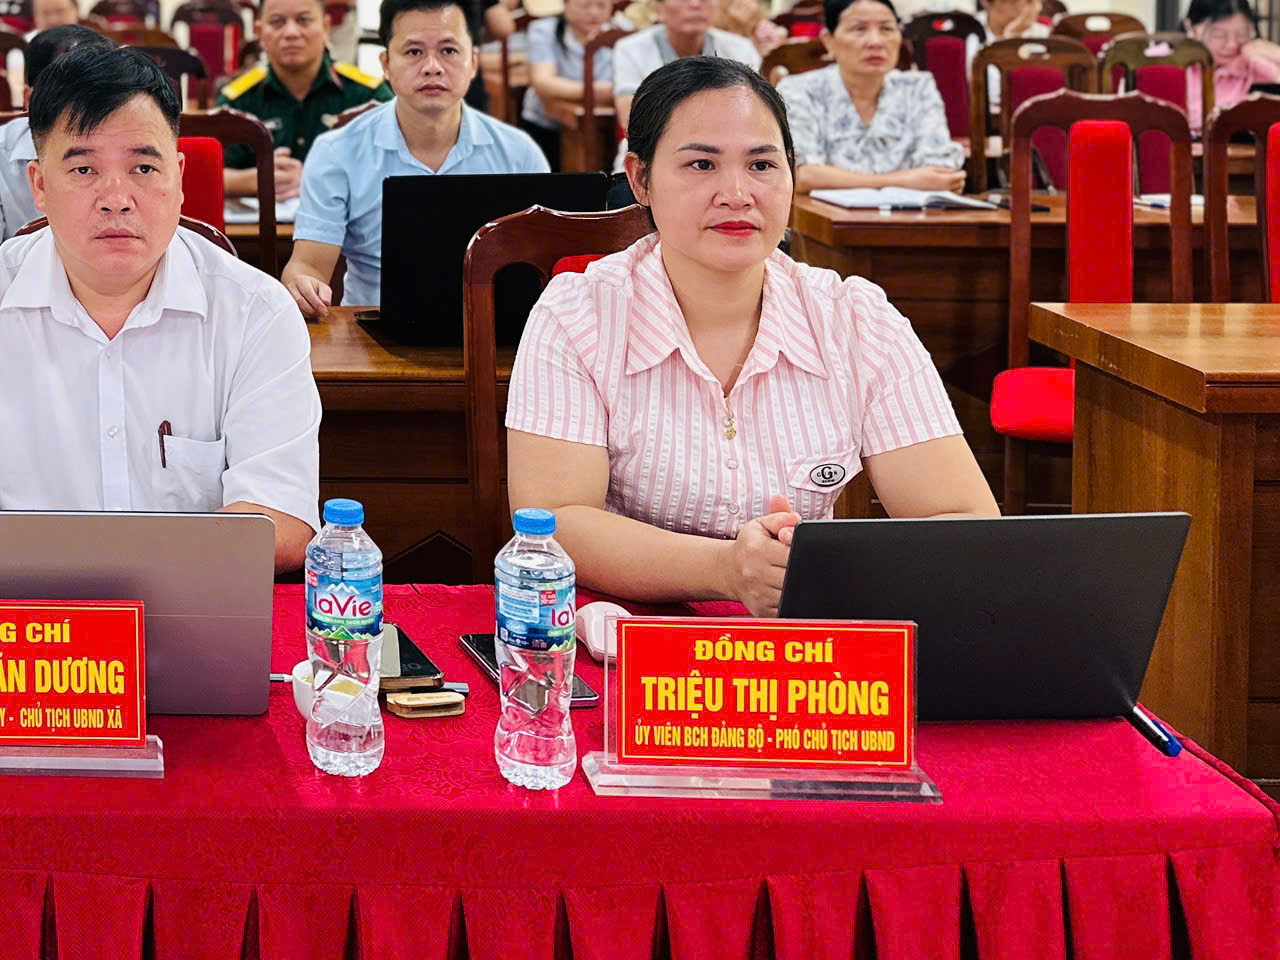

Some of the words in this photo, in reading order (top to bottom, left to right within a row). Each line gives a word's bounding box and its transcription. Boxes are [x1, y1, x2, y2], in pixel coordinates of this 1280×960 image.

[25, 618, 71, 643] CHÍ
[694, 633, 775, 661] ĐỒNG
[784, 637, 834, 663] CHÍ
[34, 656, 125, 695] DƯƠNG
[641, 669, 723, 720] TRIỆU
[732, 678, 778, 721] THỊ
[787, 671, 889, 716] PHÒNG
[20, 701, 43, 728] CHỦ
[45, 707, 71, 732] TỊCH
[73, 708, 105, 728] UBND
[107, 705, 123, 728] XÃ
[635, 718, 651, 746] ỦY
[653, 721, 681, 746] VIÊN
[684, 726, 709, 747] BCH
[711, 721, 745, 748] ĐẢNG
[747, 723, 764, 753] BỘ
[775, 723, 800, 749] PHÓ
[803, 722, 828, 750] CHỦ
[831, 729, 859, 755] TỊCH
[861, 730, 896, 752] UBND
